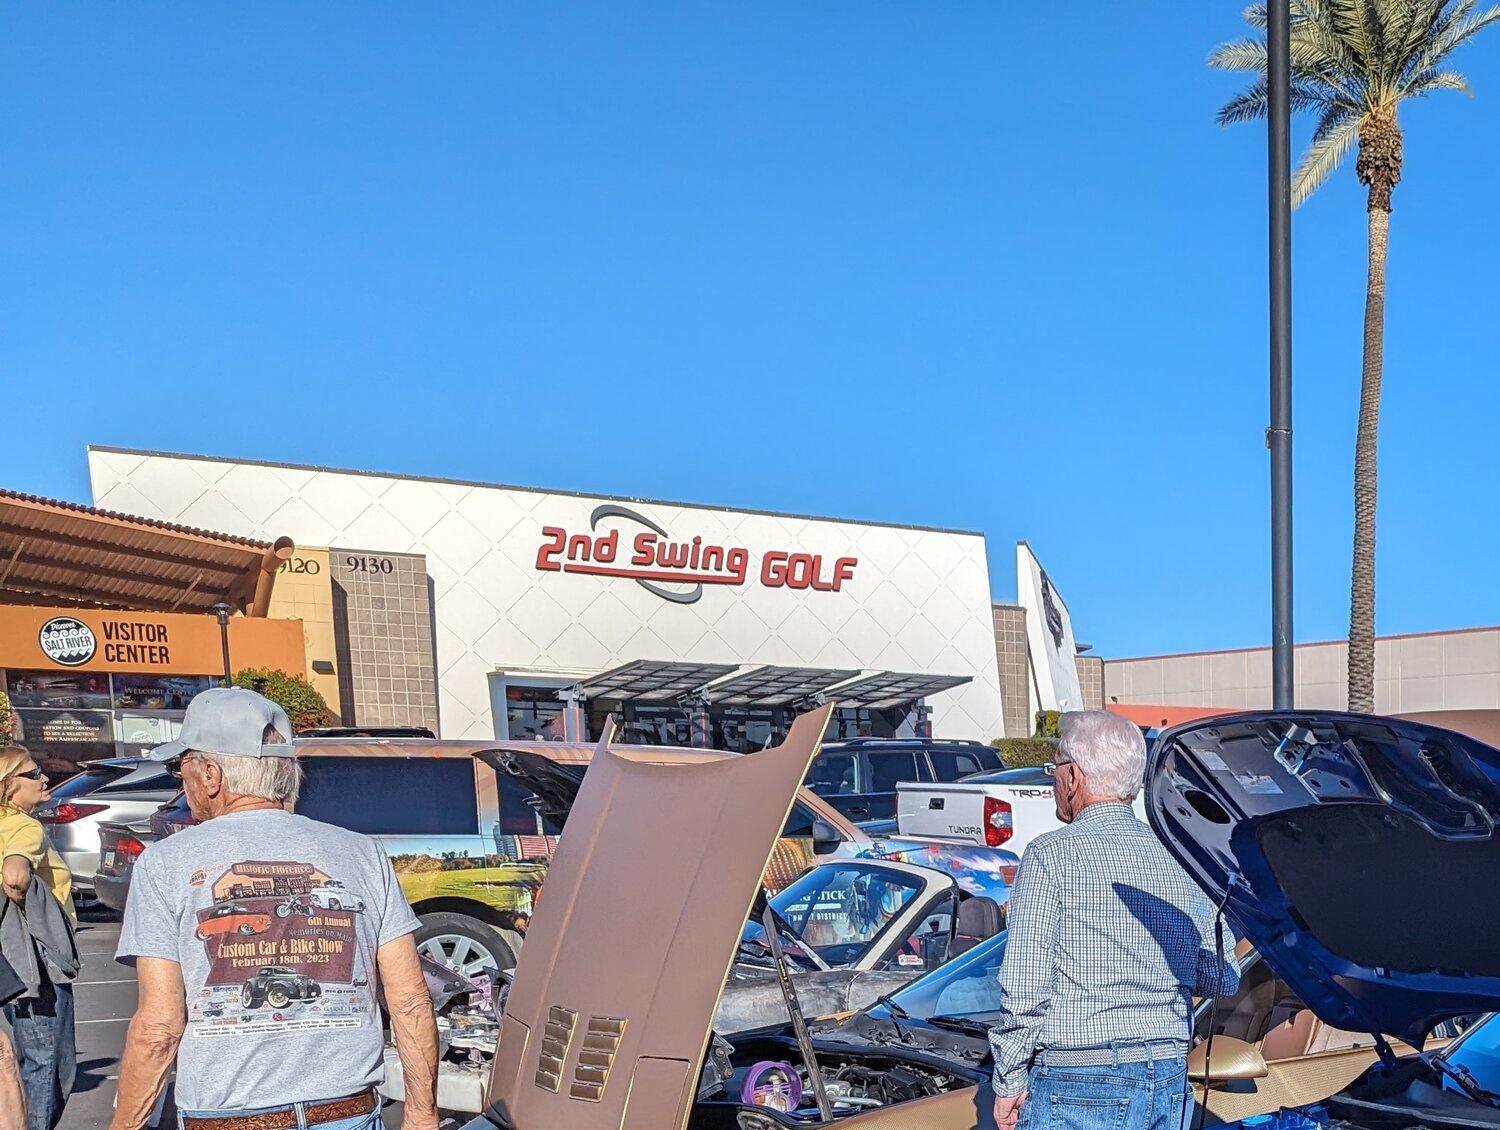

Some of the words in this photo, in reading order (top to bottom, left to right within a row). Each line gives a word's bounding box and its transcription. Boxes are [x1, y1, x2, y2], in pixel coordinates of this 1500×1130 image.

[346, 556, 394, 575] 9130
[535, 525, 619, 572] 2nd
[631, 532, 749, 585] Swing
[760, 550, 858, 592] GOLF
[50, 621, 76, 631] Discover
[101, 621, 169, 643] VISITOR
[45, 638, 66, 652] SALT
[66, 635, 92, 650] RIVER
[104, 643, 170, 665] CENTER
[948, 825, 982, 835] TUNDRA
[235, 864, 269, 874] Historic
[271, 864, 311, 875] Florence
[307, 916, 322, 926] 6th
[324, 916, 351, 927] Annual
[817, 912, 847, 921] DISTRICT
[218, 942, 256, 959] Custom
[259, 940, 278, 956] Car
[280, 939, 288, 954] &
[290, 939, 315, 954] Bike
[318, 938, 343, 954] Show
[232, 957, 276, 968] February
[306, 955, 329, 963] 2023
